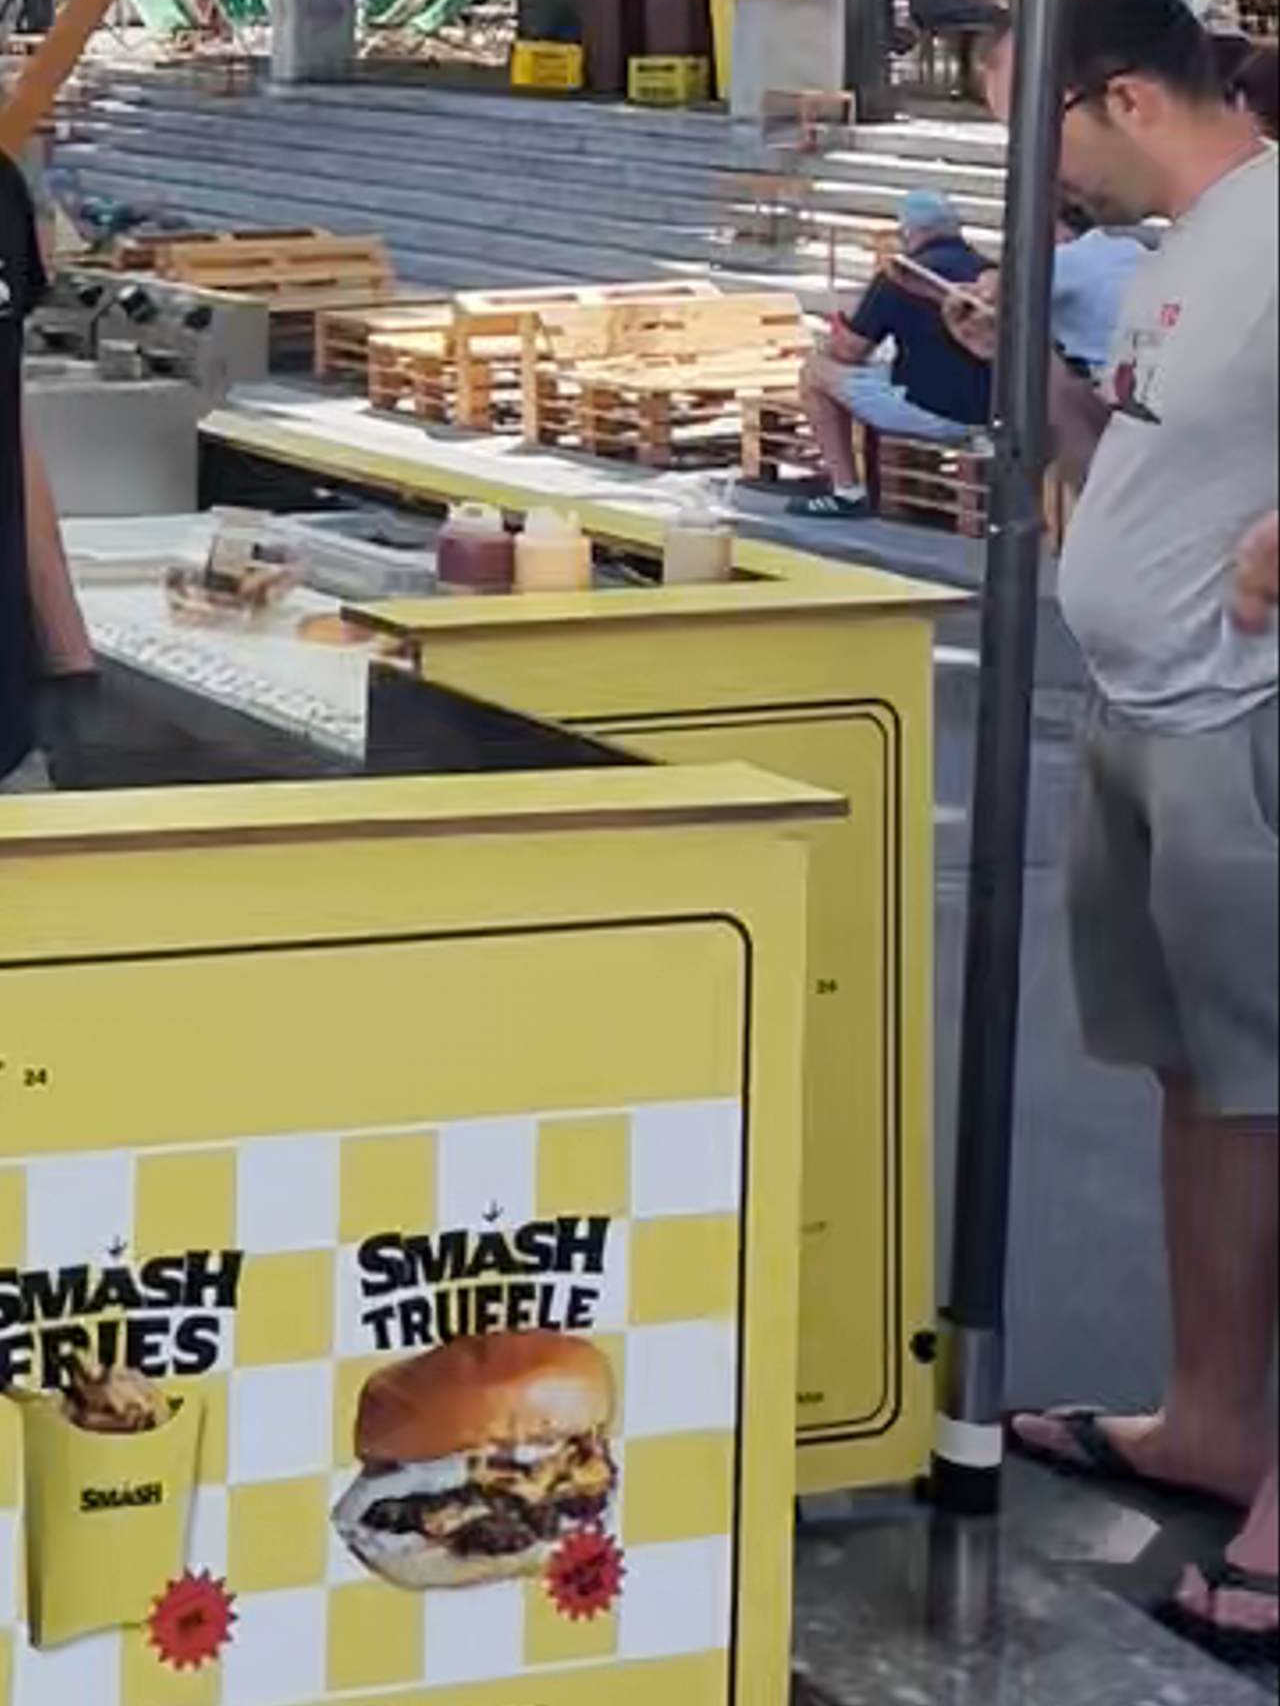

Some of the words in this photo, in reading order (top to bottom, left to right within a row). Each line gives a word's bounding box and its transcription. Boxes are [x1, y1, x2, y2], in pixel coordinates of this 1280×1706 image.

[24, 1069, 48, 1087] 24
[357, 1215, 610, 1298] SMASH
[360, 1282, 599, 1351] TRUFFLE
[80, 1482, 163, 1513] SMASH
